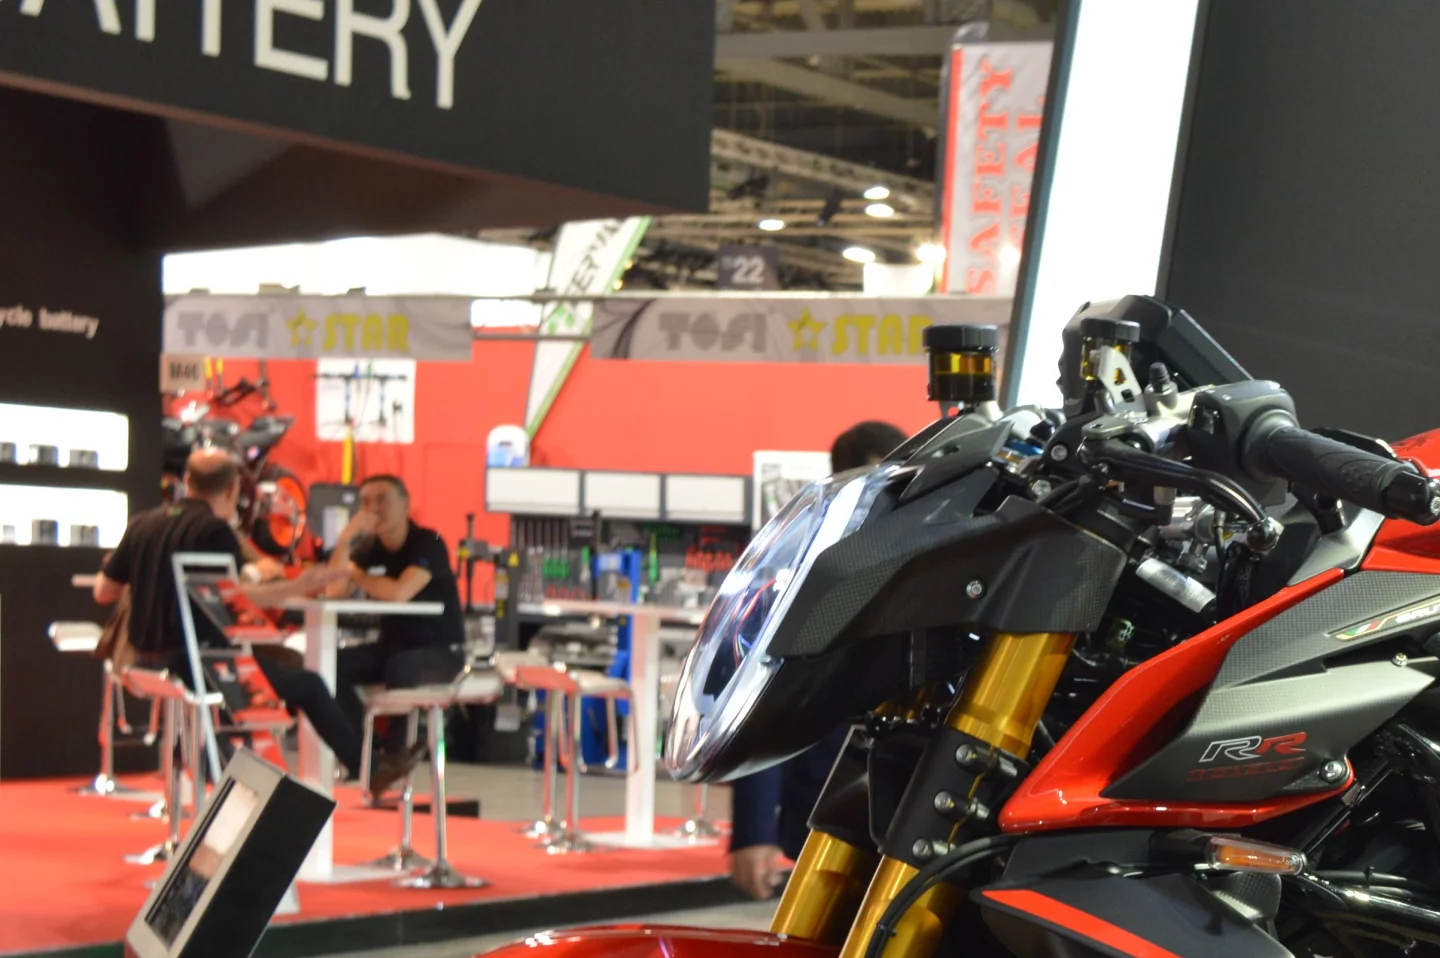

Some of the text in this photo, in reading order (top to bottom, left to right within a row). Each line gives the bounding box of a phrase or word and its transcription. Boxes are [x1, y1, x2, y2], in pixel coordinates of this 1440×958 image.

[966, 57, 1012, 294] SAFETY
[731, 256, 766, 284] 22
[322, 313, 410, 351] STAR
[1198, 731, 1307, 763] RR
